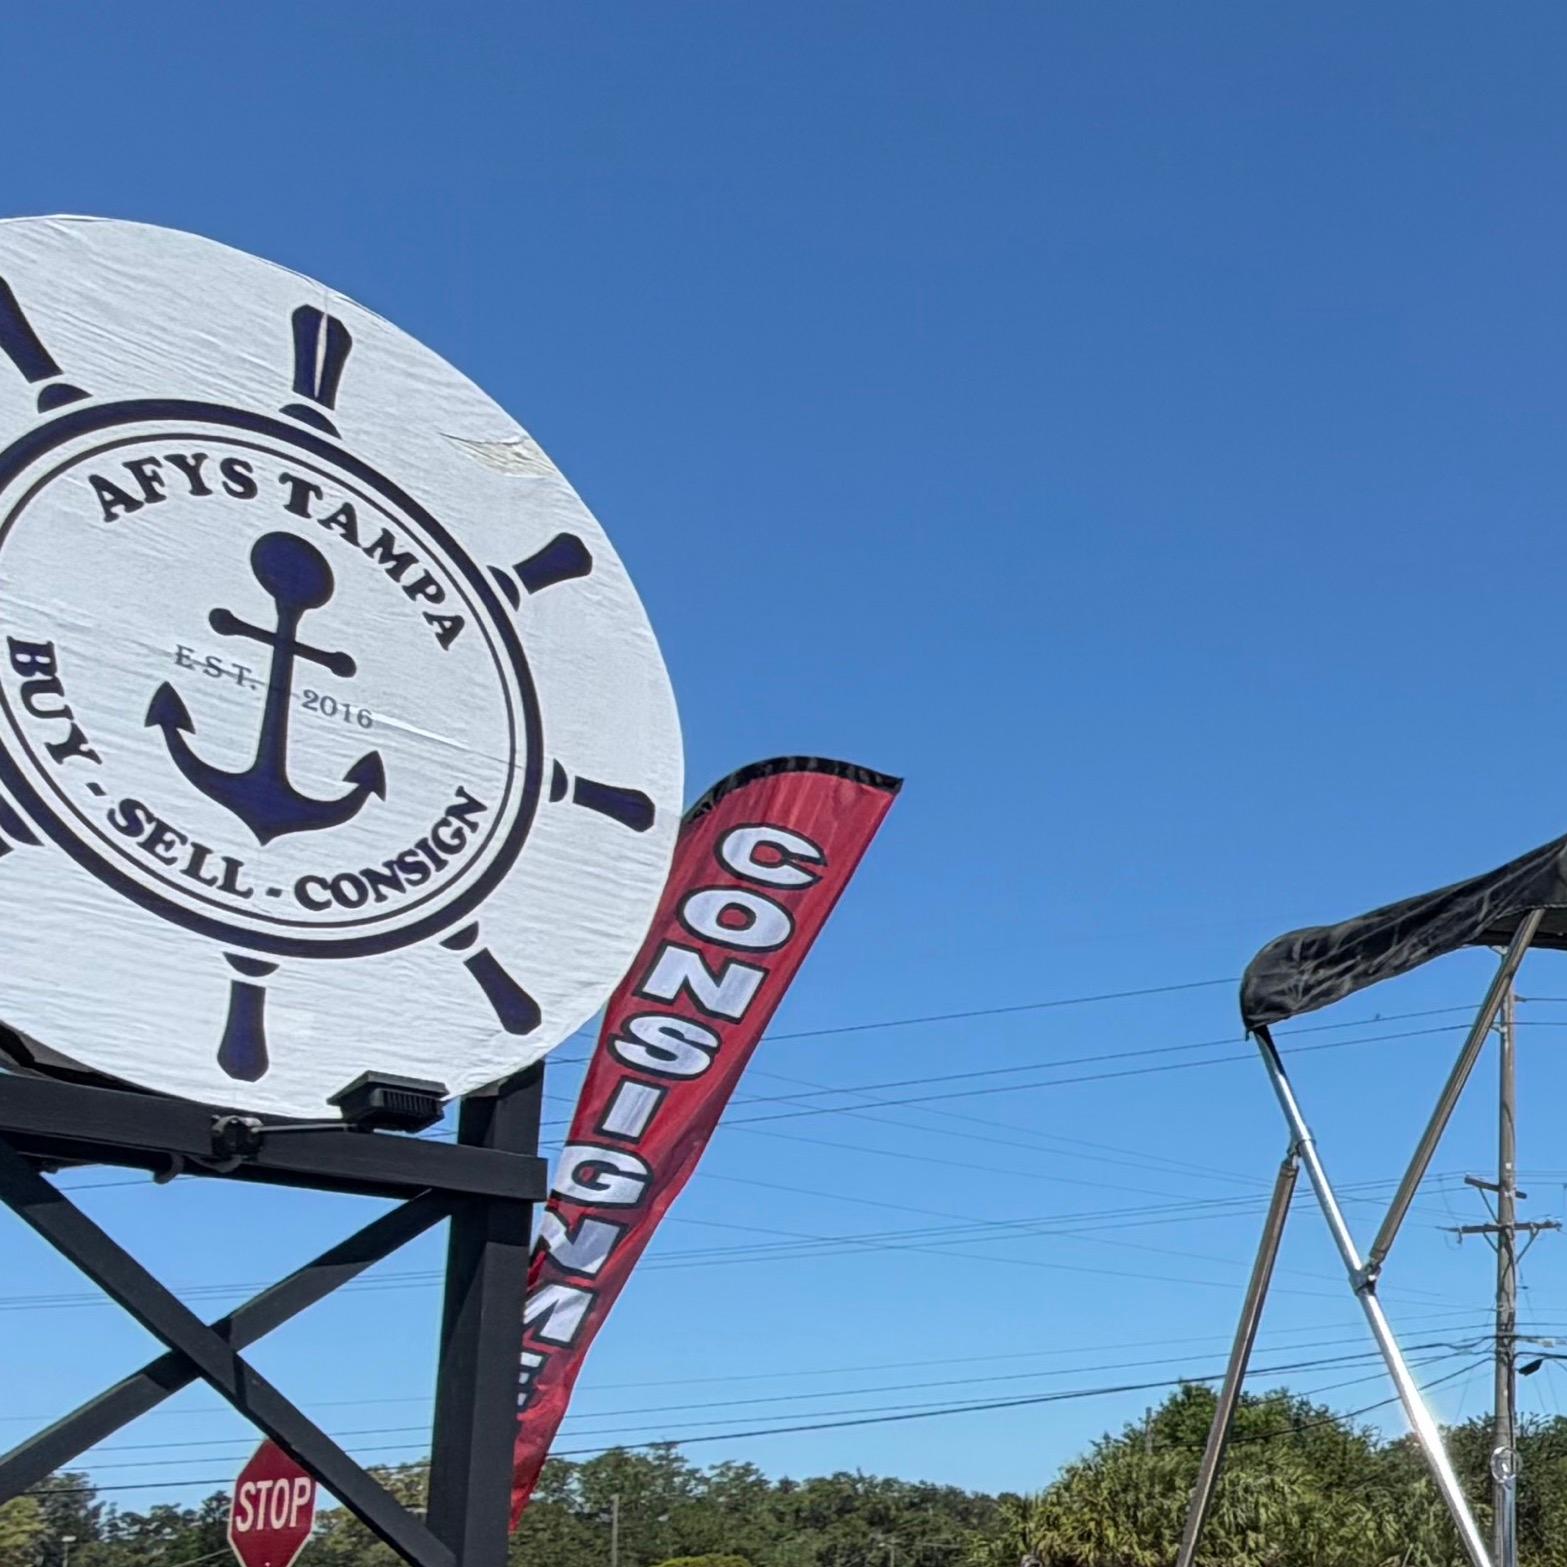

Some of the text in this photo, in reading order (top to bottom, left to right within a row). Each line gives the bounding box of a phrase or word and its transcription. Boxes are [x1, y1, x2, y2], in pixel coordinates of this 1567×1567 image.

[88, 450, 467, 651] AFYS TAMPA
[175, 644, 374, 729] EST. 2016
[6, 634, 102, 768] BUY
[107, 797, 255, 900] SELL
[294, 786, 490, 912] CONSIGN
[235, 1476, 311, 1532] STOP
